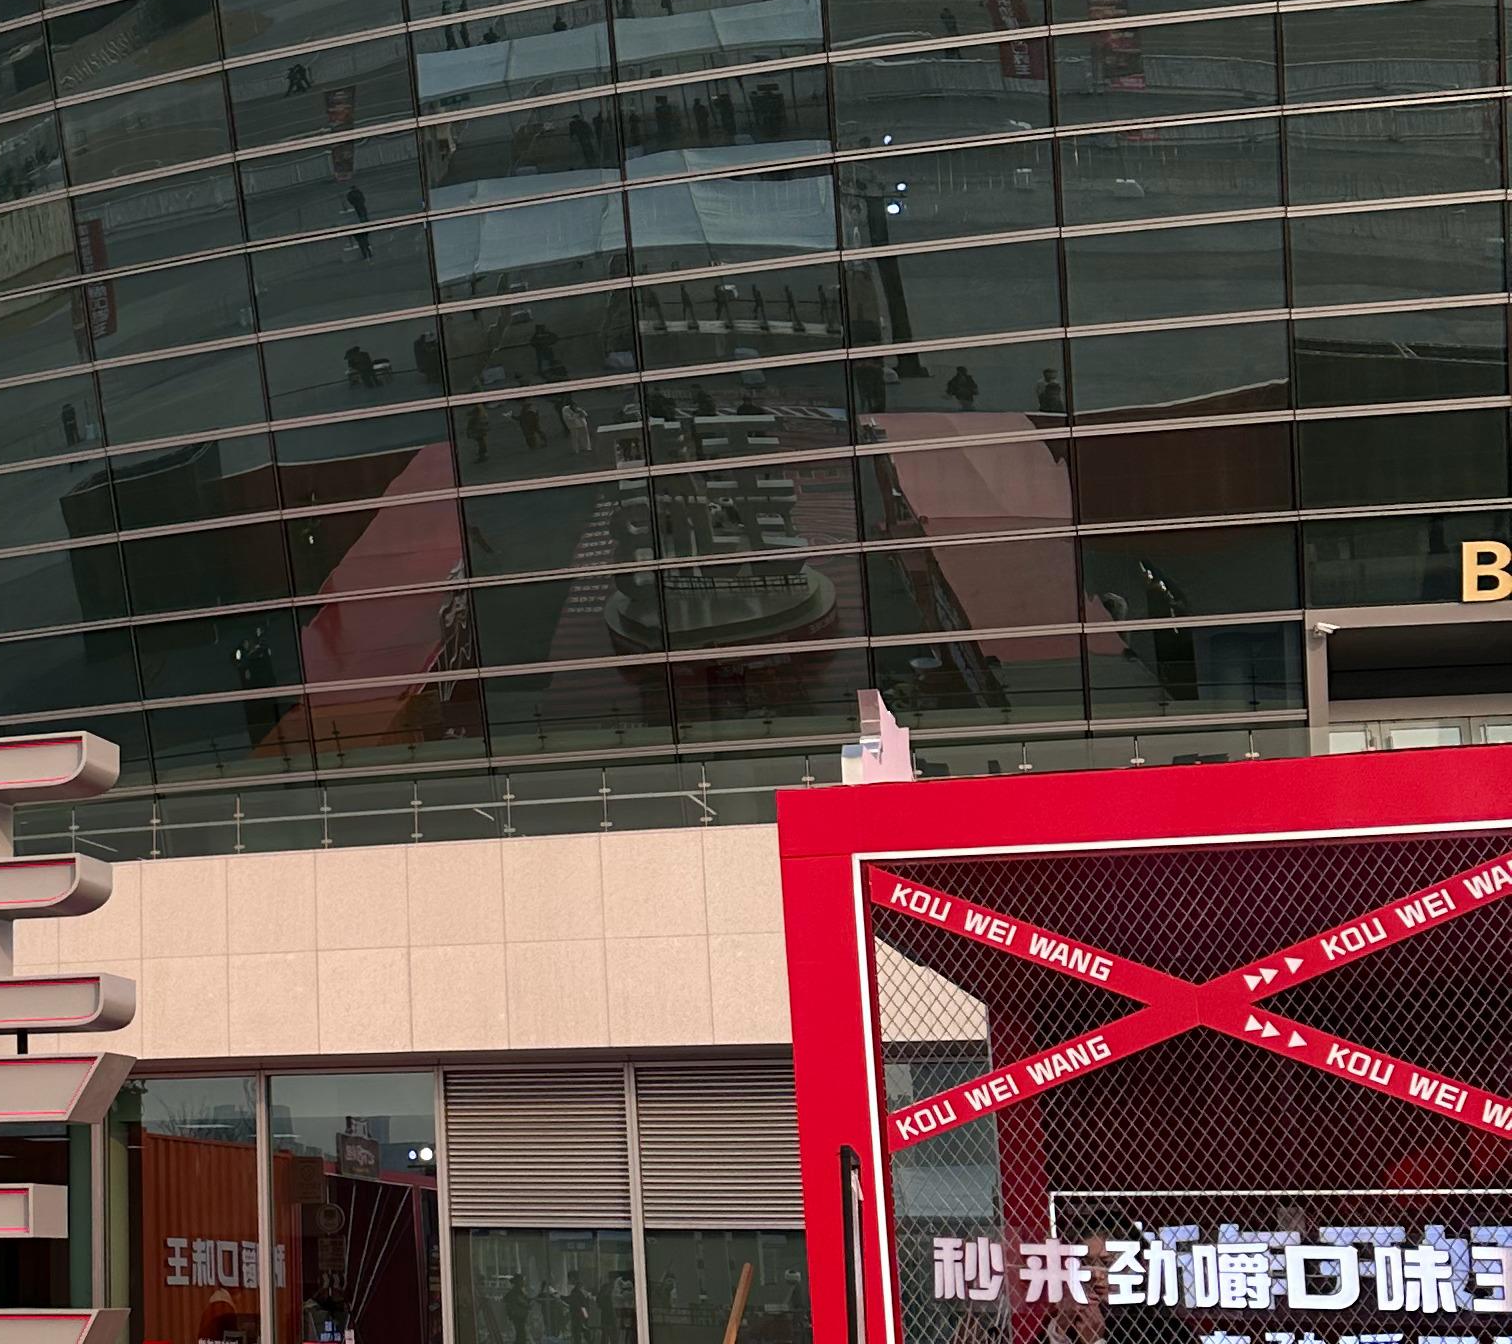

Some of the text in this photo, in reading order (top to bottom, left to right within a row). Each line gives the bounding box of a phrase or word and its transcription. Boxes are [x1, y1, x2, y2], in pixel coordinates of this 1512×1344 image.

[890, 882, 1113, 982] KOU WEI WANG
[1320, 916, 1387, 961] KOU
[1395, 886, 1457, 930] WEI
[895, 1036, 1112, 1140] KOU WEI WANG
[1324, 1043, 1395, 1087] KOU
[1408, 1072, 1467, 1114] WEI
